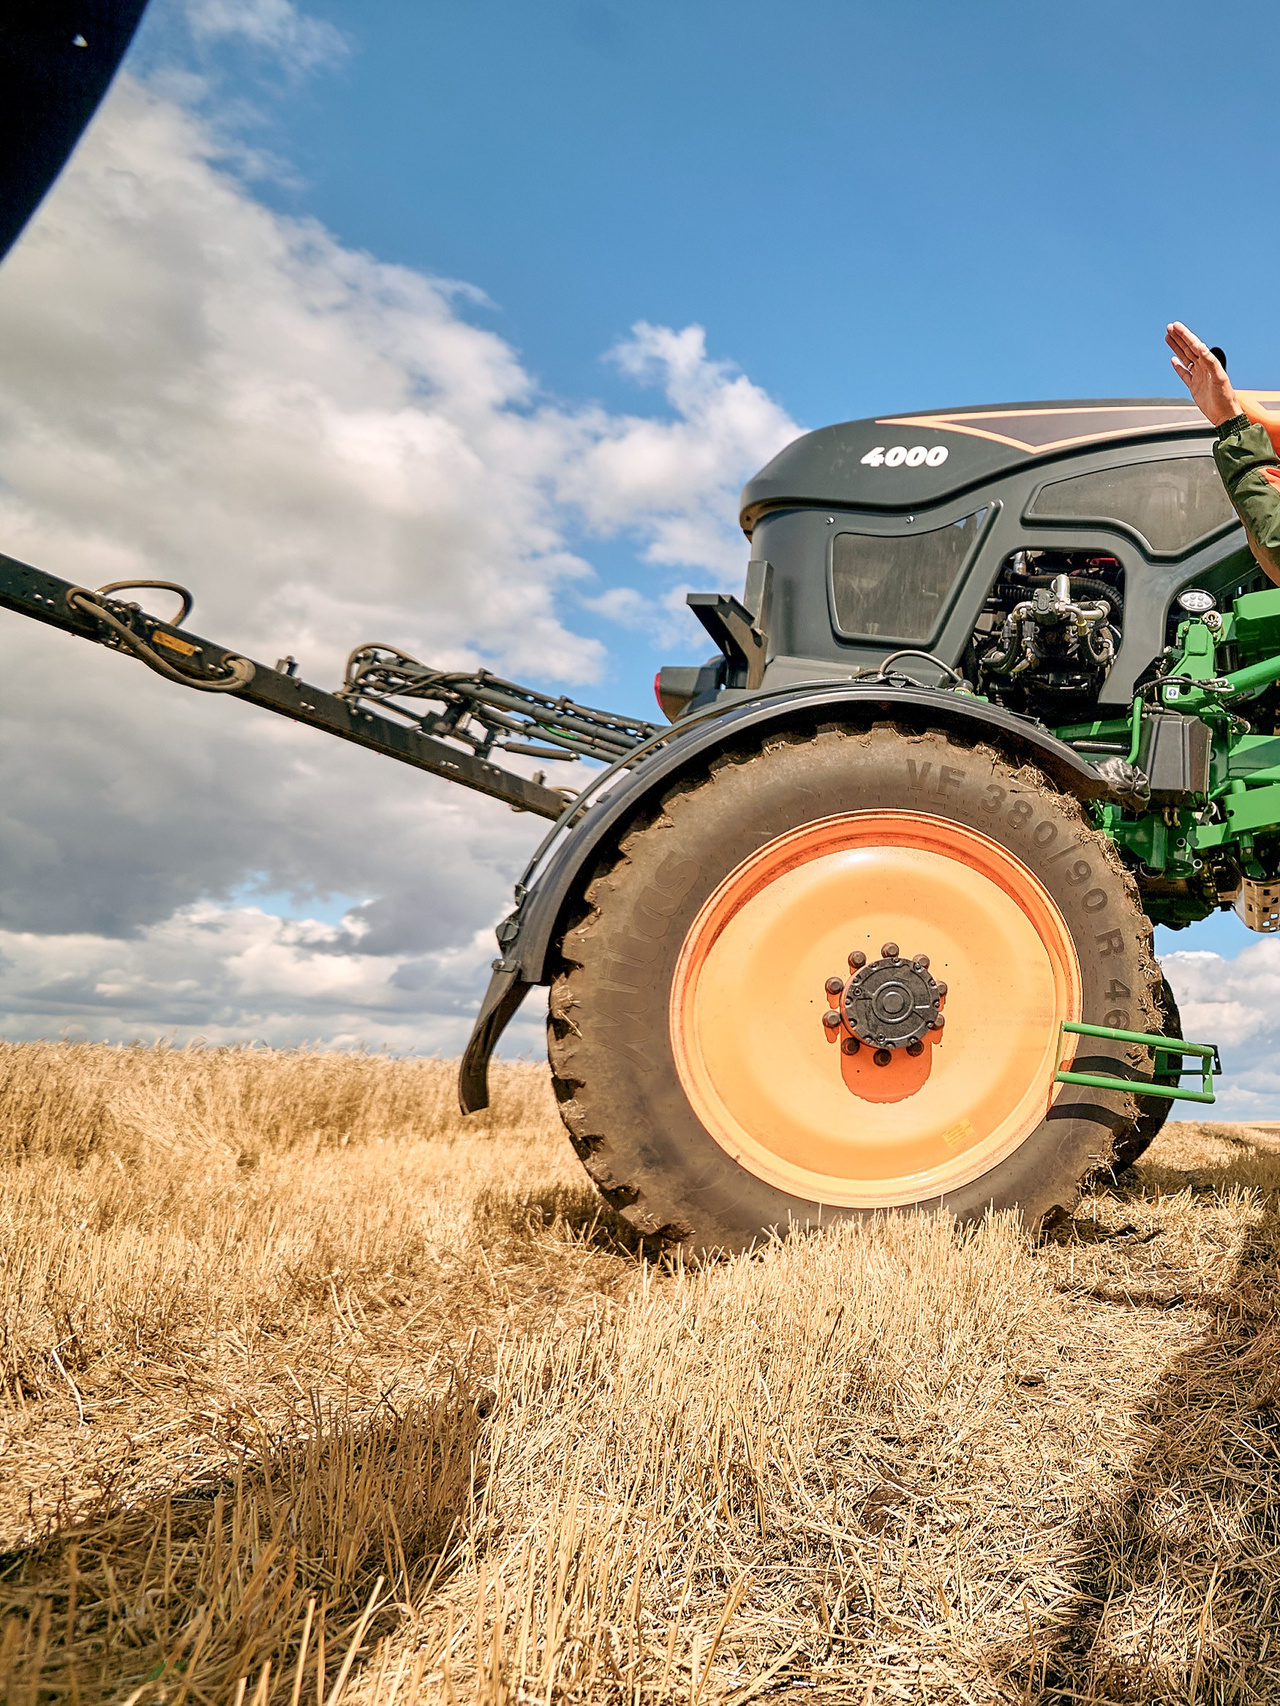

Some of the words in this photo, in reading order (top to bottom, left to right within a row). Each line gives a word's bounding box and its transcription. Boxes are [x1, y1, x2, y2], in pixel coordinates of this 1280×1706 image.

[860, 446, 949, 467] 4000
[906, 758, 966, 796] VF
[980, 783, 1108, 914] 380/90
[592, 849, 701, 1073] Mitas
[1094, 927, 1125, 958] R
[1103, 977, 1132, 1030] 46
